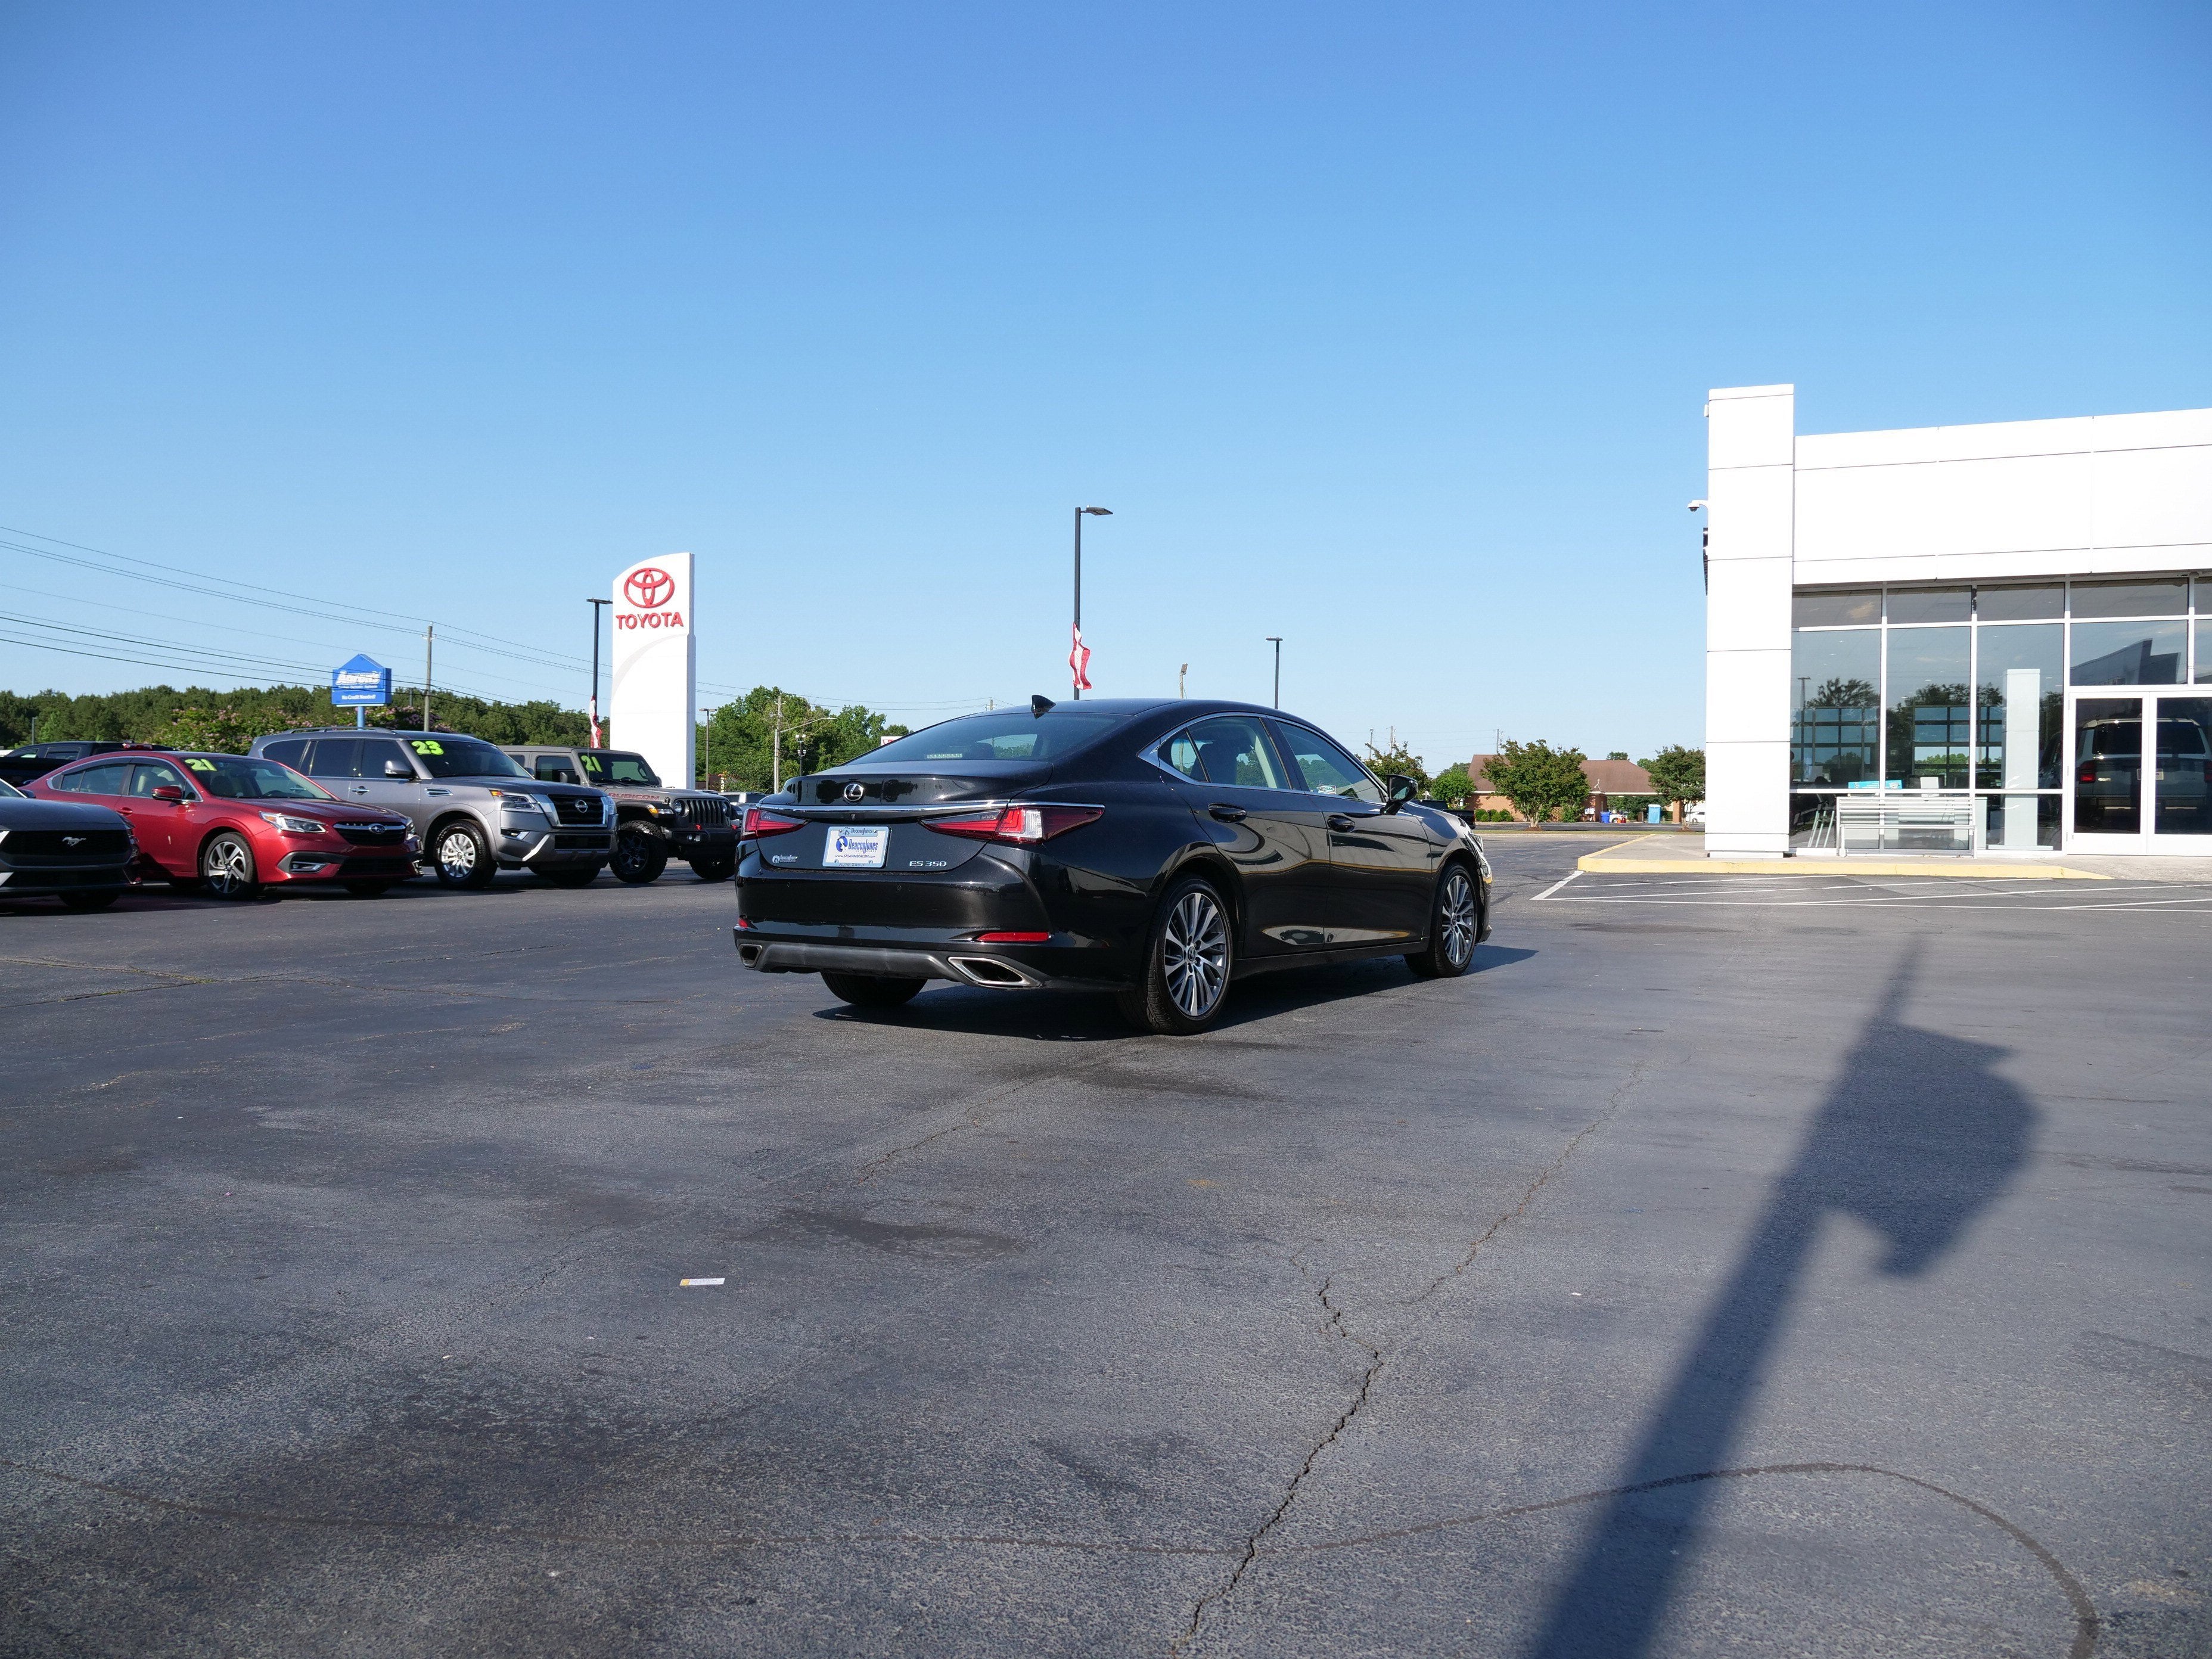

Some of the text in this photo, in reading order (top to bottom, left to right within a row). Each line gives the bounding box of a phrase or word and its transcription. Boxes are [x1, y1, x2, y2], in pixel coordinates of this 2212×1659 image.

[616, 612, 684, 629] TOYOTA
[335, 670, 381, 685] Aaron's
[412, 741, 444, 755] 23
[185, 759, 218, 772] 21
[581, 755, 602, 773] 21
[608, 793, 660, 801] RUBICON
